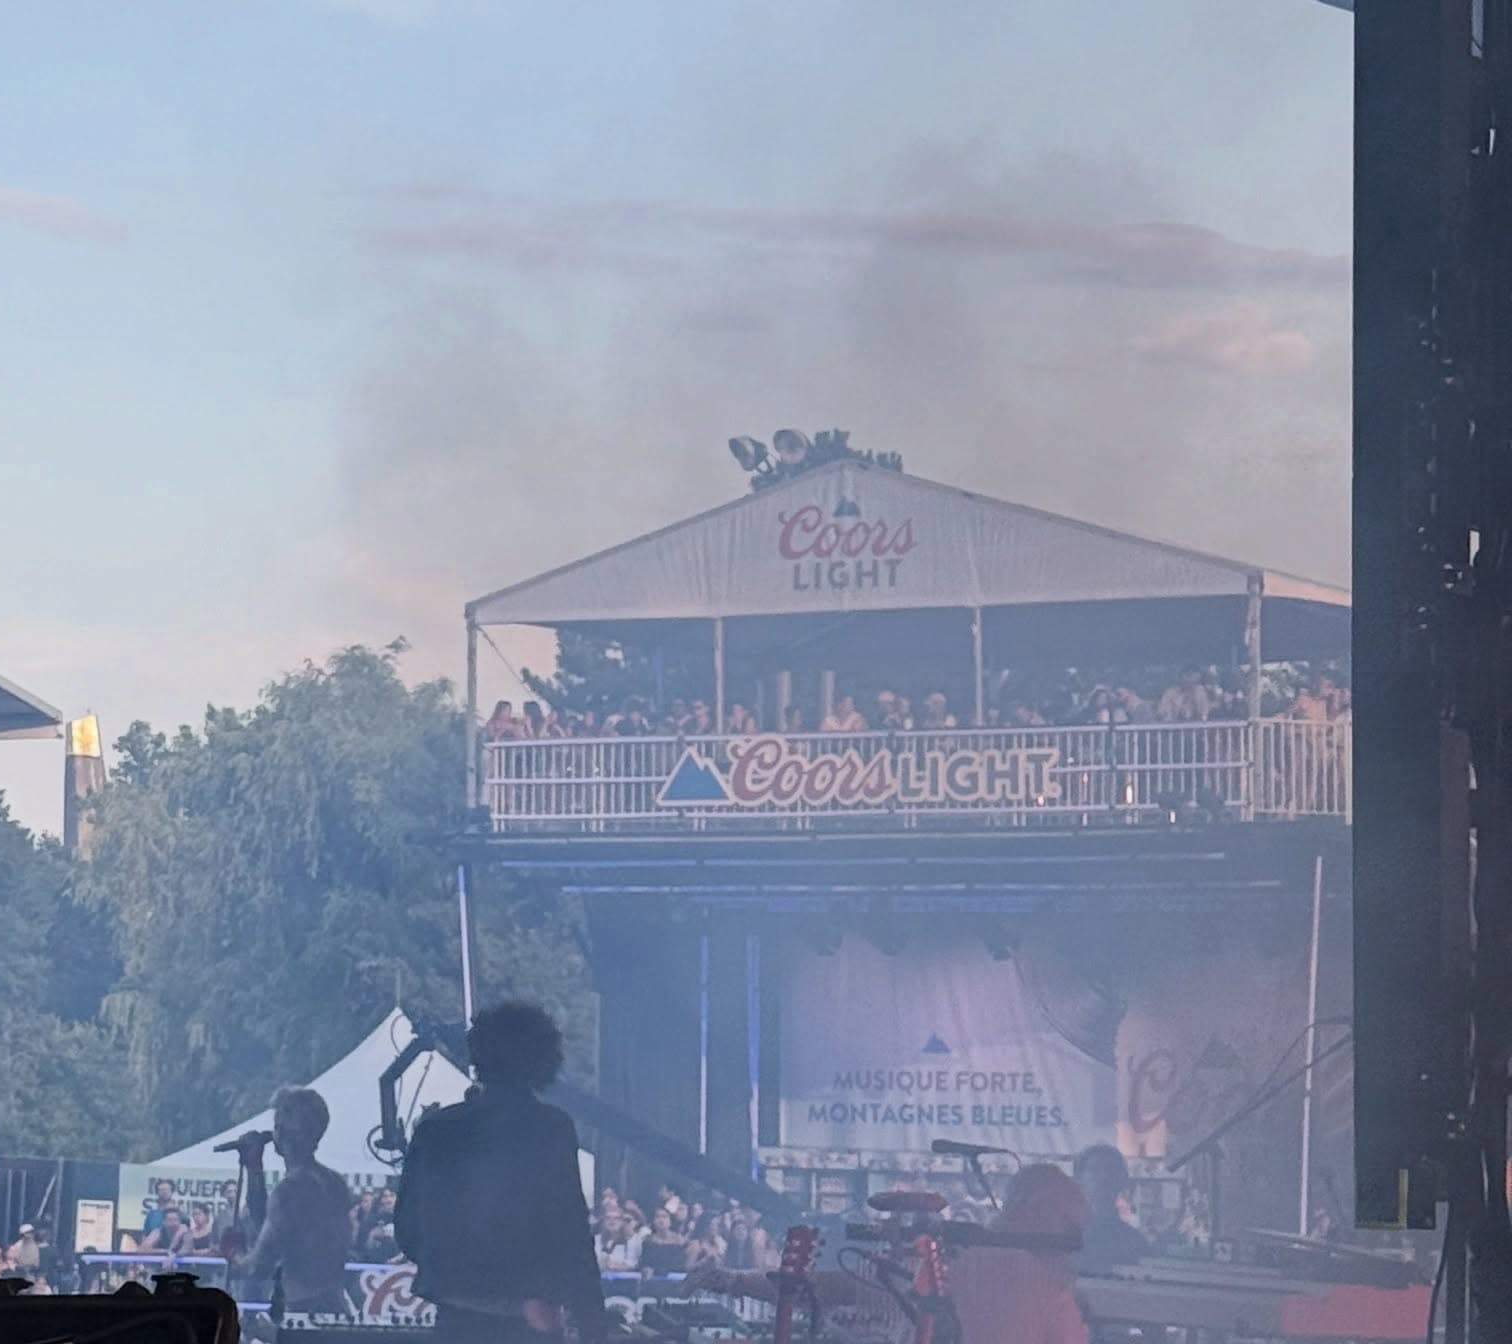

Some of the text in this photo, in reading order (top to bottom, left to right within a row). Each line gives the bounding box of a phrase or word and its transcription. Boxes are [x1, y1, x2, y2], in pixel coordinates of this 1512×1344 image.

[778, 505, 918, 560] Coors
[793, 558, 903, 591] LIGHT
[729, 736, 1059, 804] Coors LIGHT
[832, 1069, 1044, 1097] MUSIQUE FORTE,
[807, 1103, 963, 1126] MONTAGNES
